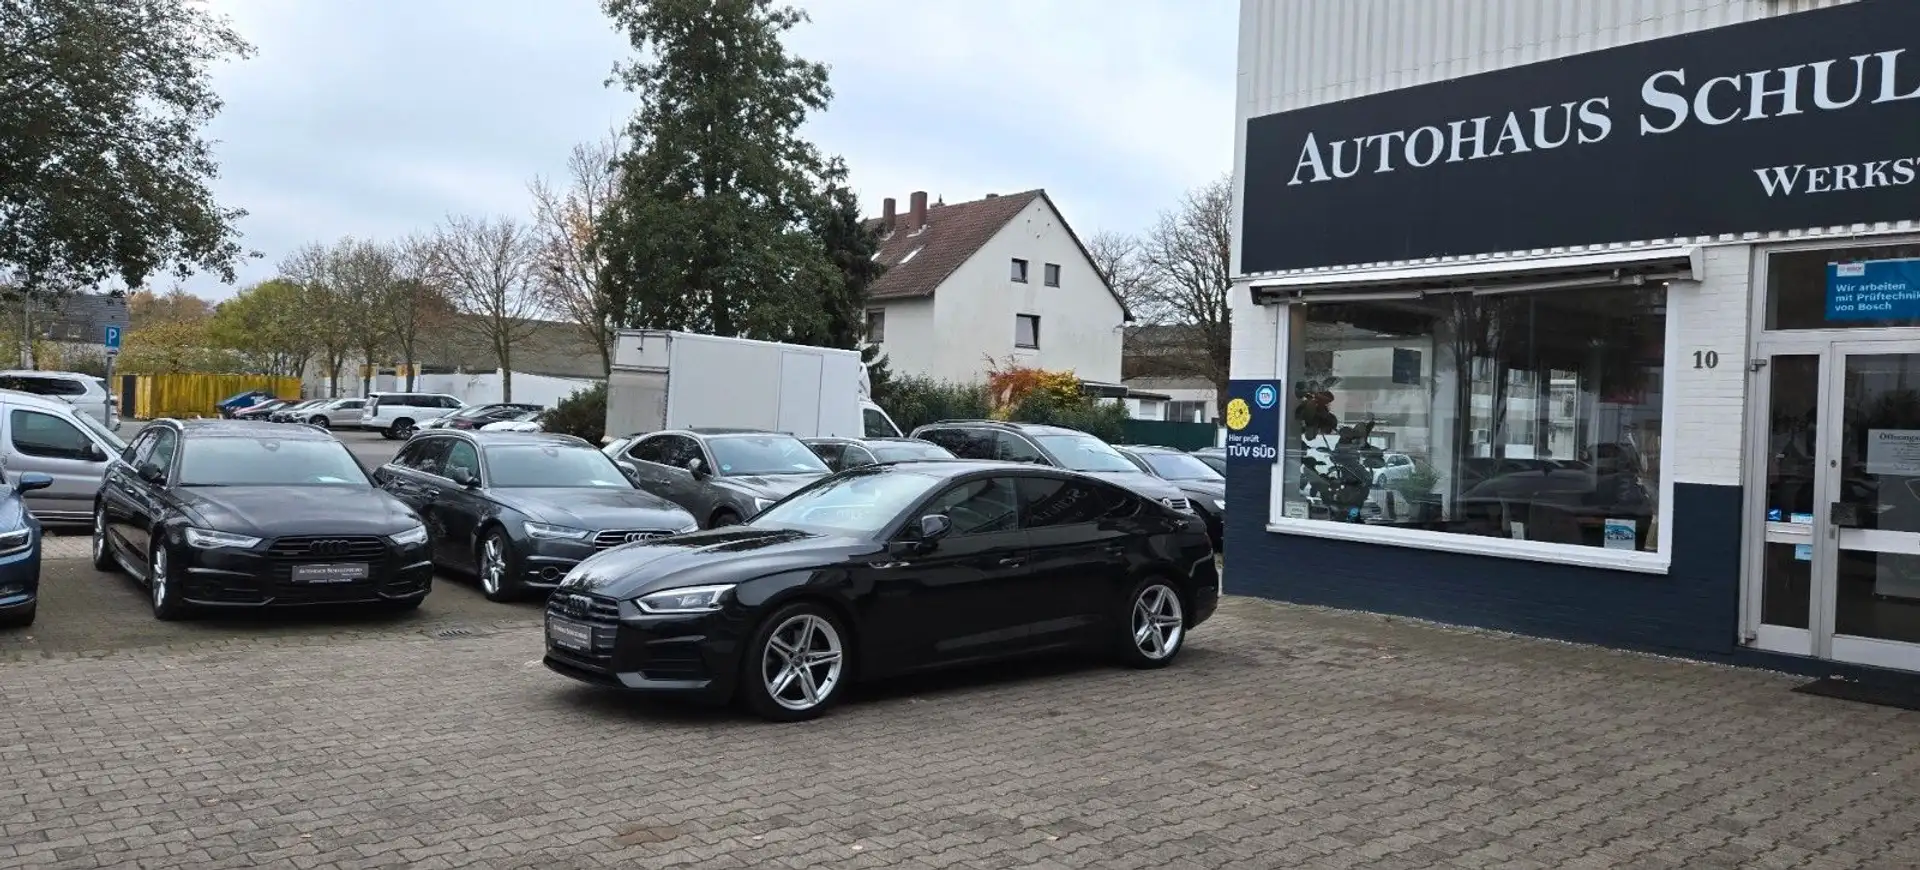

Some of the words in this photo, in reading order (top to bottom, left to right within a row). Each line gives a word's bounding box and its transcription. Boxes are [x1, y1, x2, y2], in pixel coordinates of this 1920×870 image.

[1287, 96, 1613, 186] AUTOHAUS
[1753, 157, 1920, 197] WERKS
[1836, 283, 1856, 292] Wir
[1860, 282, 1906, 291] arbeiten
[1835, 294, 1853, 302] mit
[1858, 301, 1892, 311] Bosch
[108, 328, 117, 344] P
[1693, 350, 1718, 369] 10
[1243, 434, 1260, 443] prüft
[1228, 443, 1250, 457] TÜV
[1252, 444, 1276, 459] SÜD
